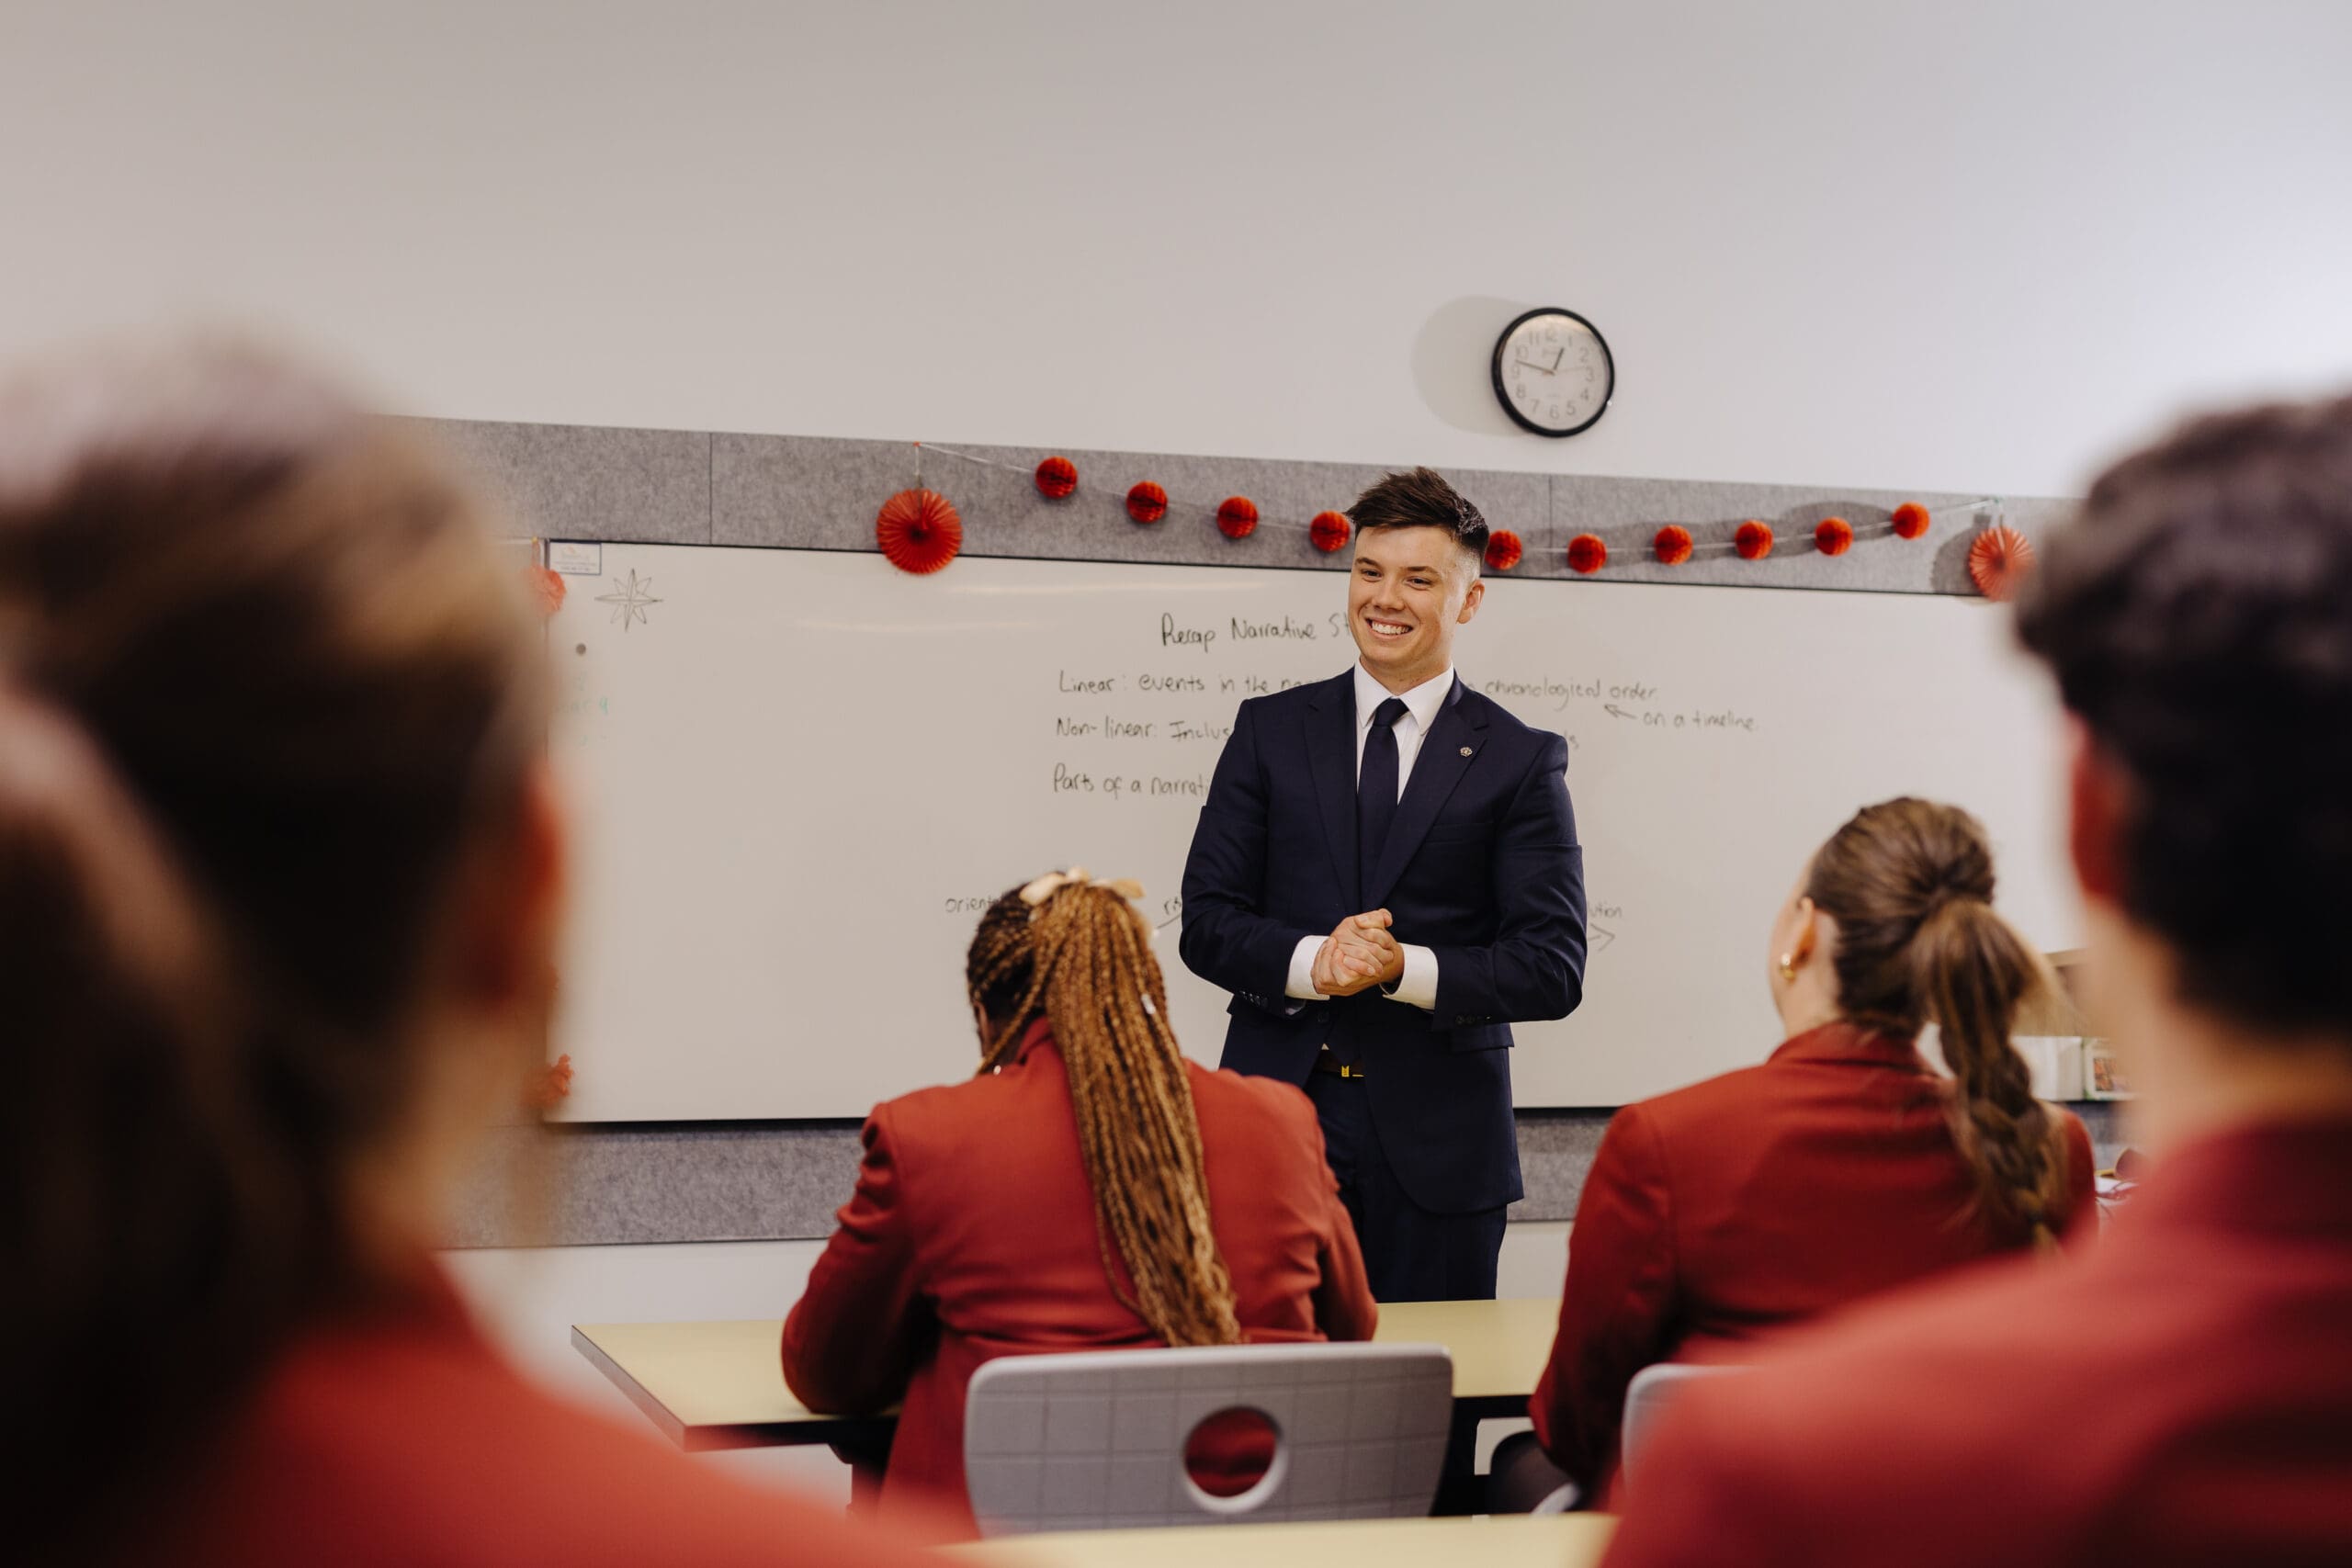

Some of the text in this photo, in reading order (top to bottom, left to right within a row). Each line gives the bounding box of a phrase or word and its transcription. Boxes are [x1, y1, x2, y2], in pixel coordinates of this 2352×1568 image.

[1160, 612, 1216, 653] Recap
[1231, 615, 1317, 641] Narrative
[1138, 673, 1205, 693] events
[1609, 683, 1657, 700] order
[1643, 712, 1666, 728] on
[1674, 714, 1685, 728] a
[1054, 761, 1094, 794] Parts
[1103, 775, 1123, 801] of
[1131, 779, 1142, 793] a
